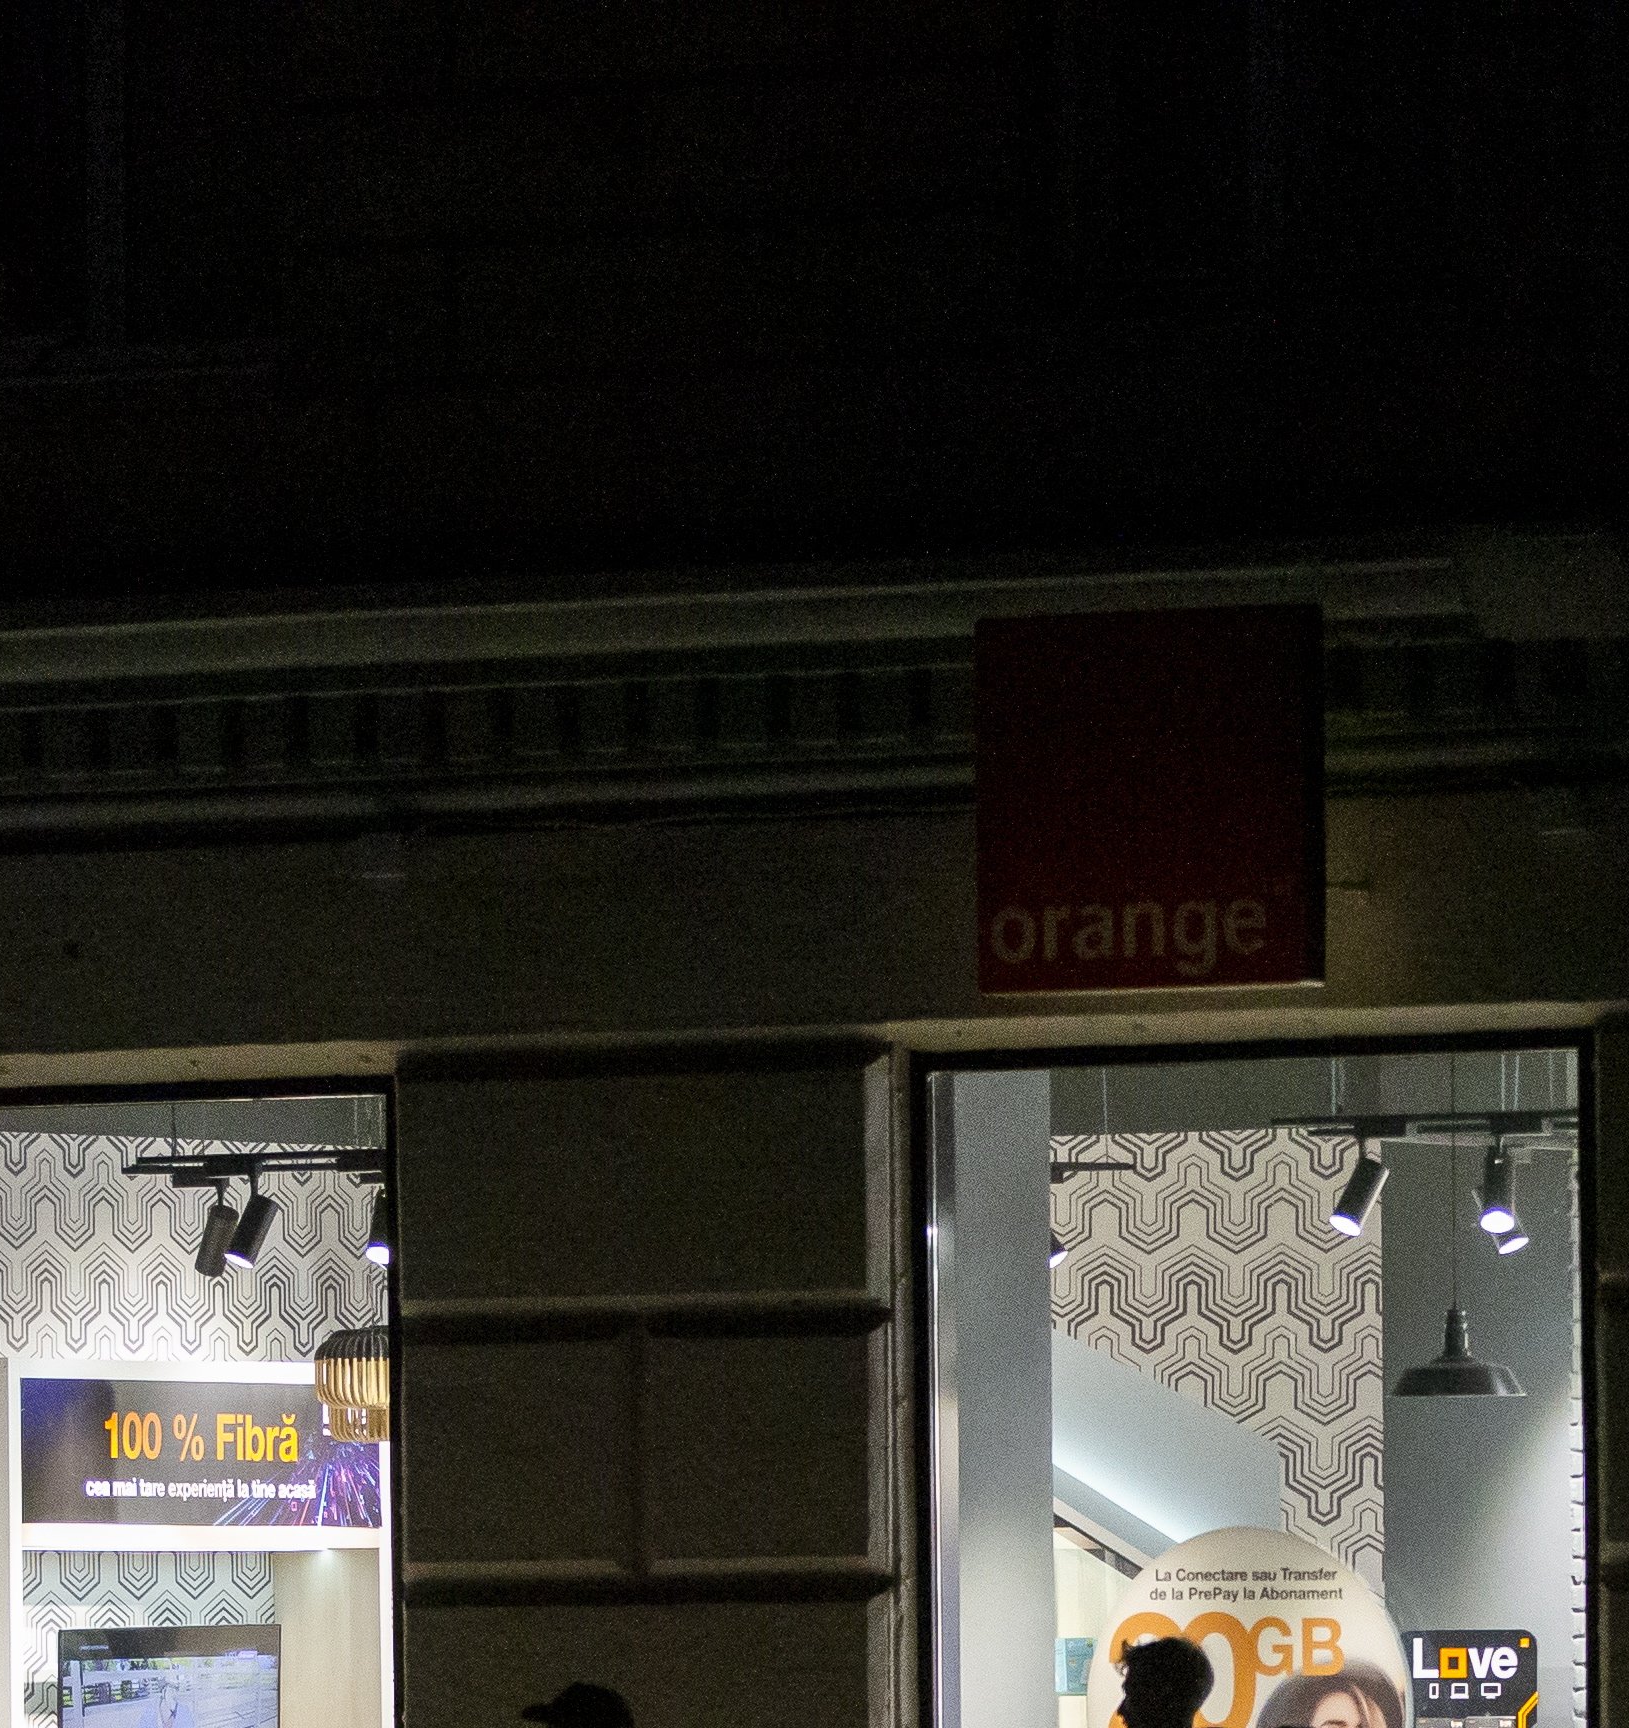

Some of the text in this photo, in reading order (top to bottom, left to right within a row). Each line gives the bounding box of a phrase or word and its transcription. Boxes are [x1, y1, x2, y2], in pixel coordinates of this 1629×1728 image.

[988, 899, 1268, 976] orange
[104, 1411, 163, 1461] 100
[173, 1413, 205, 1463] %
[216, 1412, 299, 1463] Fibră
[85, 1480, 111, 1497] cea
[112, 1477, 137, 1497] mai
[139, 1479, 165, 1497] tare
[237, 1479, 251, 1499] la
[252, 1479, 276, 1499] tine
[1155, 1567, 1337, 1582] La Conectare sau Transfer
[1149, 1586, 1344, 1603] de la PrePay la Abonament
[1412, 1637, 1519, 1680] Love
